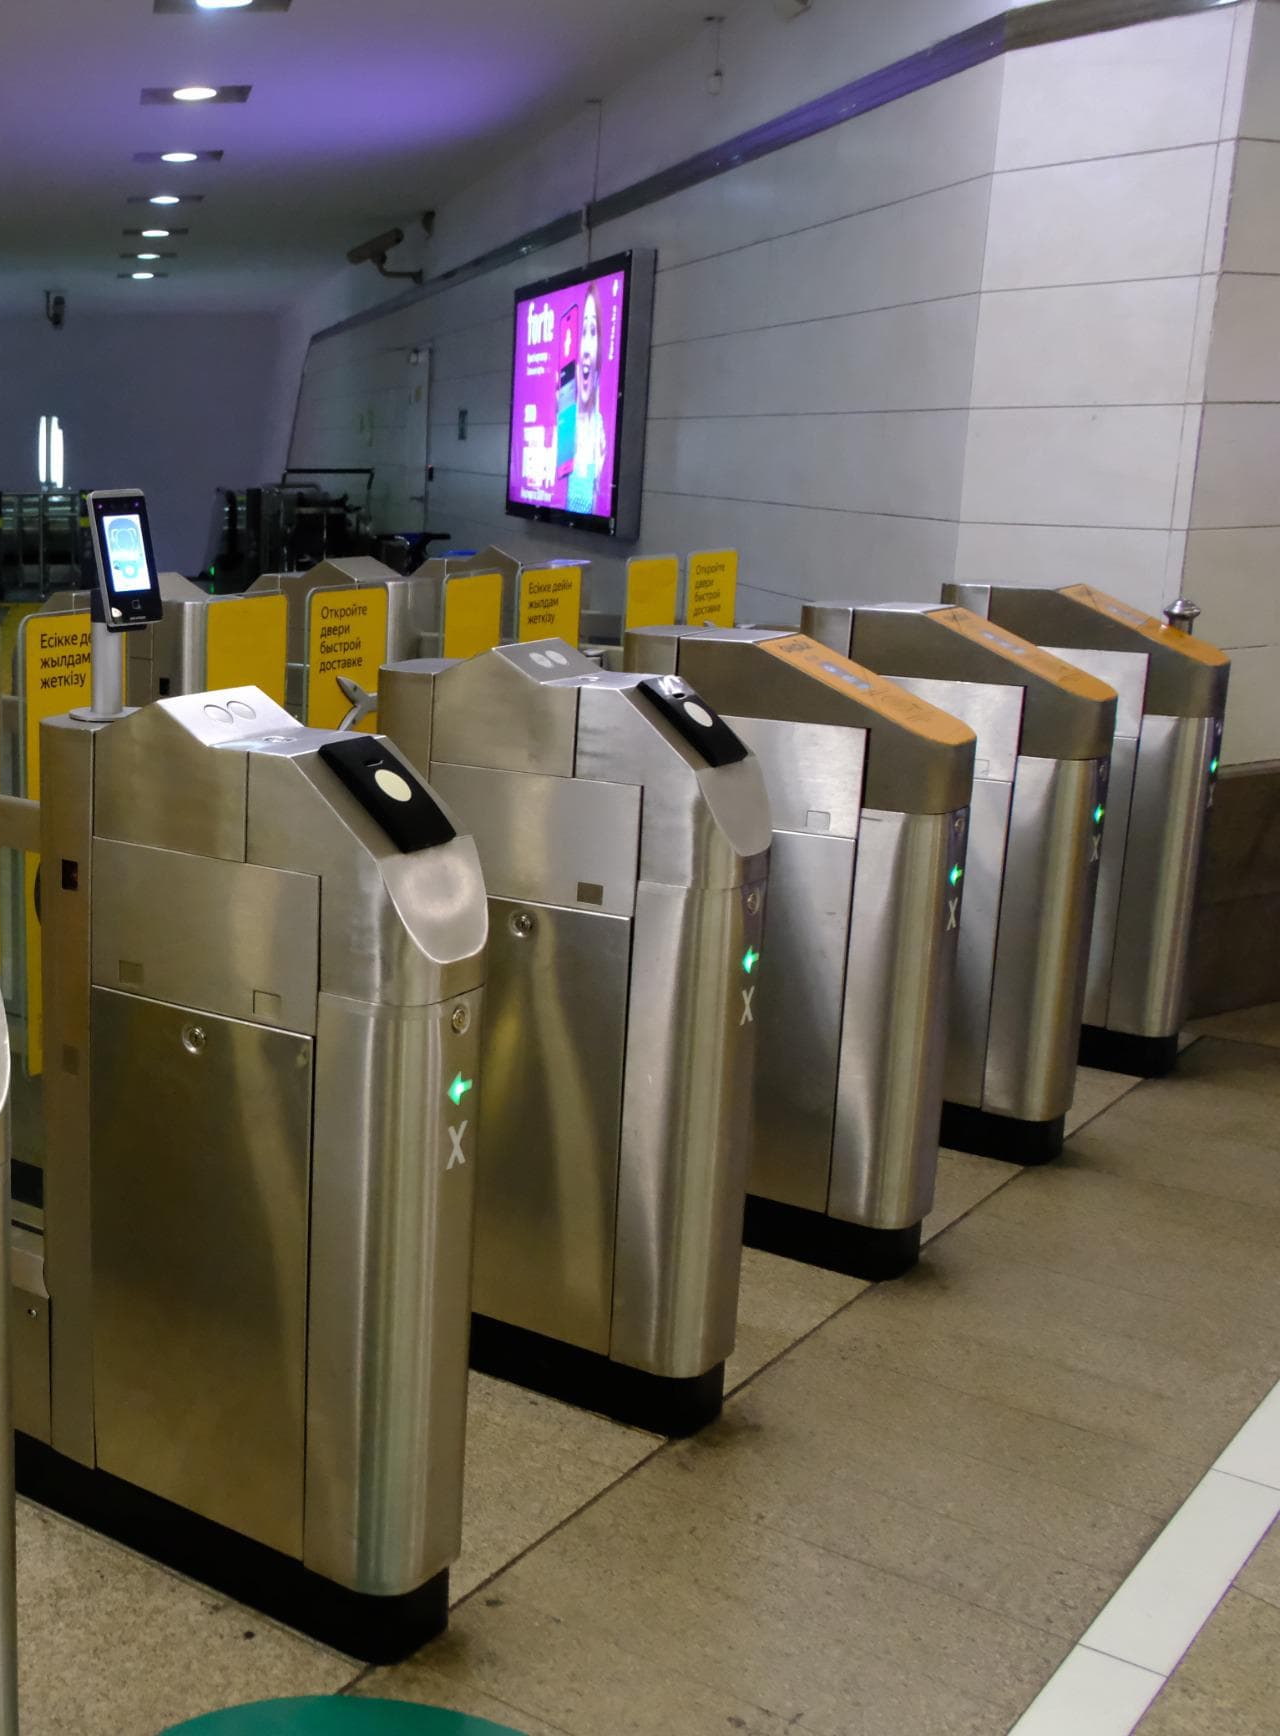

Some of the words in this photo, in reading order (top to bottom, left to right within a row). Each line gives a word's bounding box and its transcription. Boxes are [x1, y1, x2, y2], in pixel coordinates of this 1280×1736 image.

[321, 604, 368, 620] Откройте
[320, 624, 350, 639] двери
[40, 632, 78, 649] Есікке
[320, 637, 361, 654] быстрой
[40, 652, 91, 669] жылдам
[319, 656, 363, 674] доставке
[40, 670, 86, 689] жеткізу
